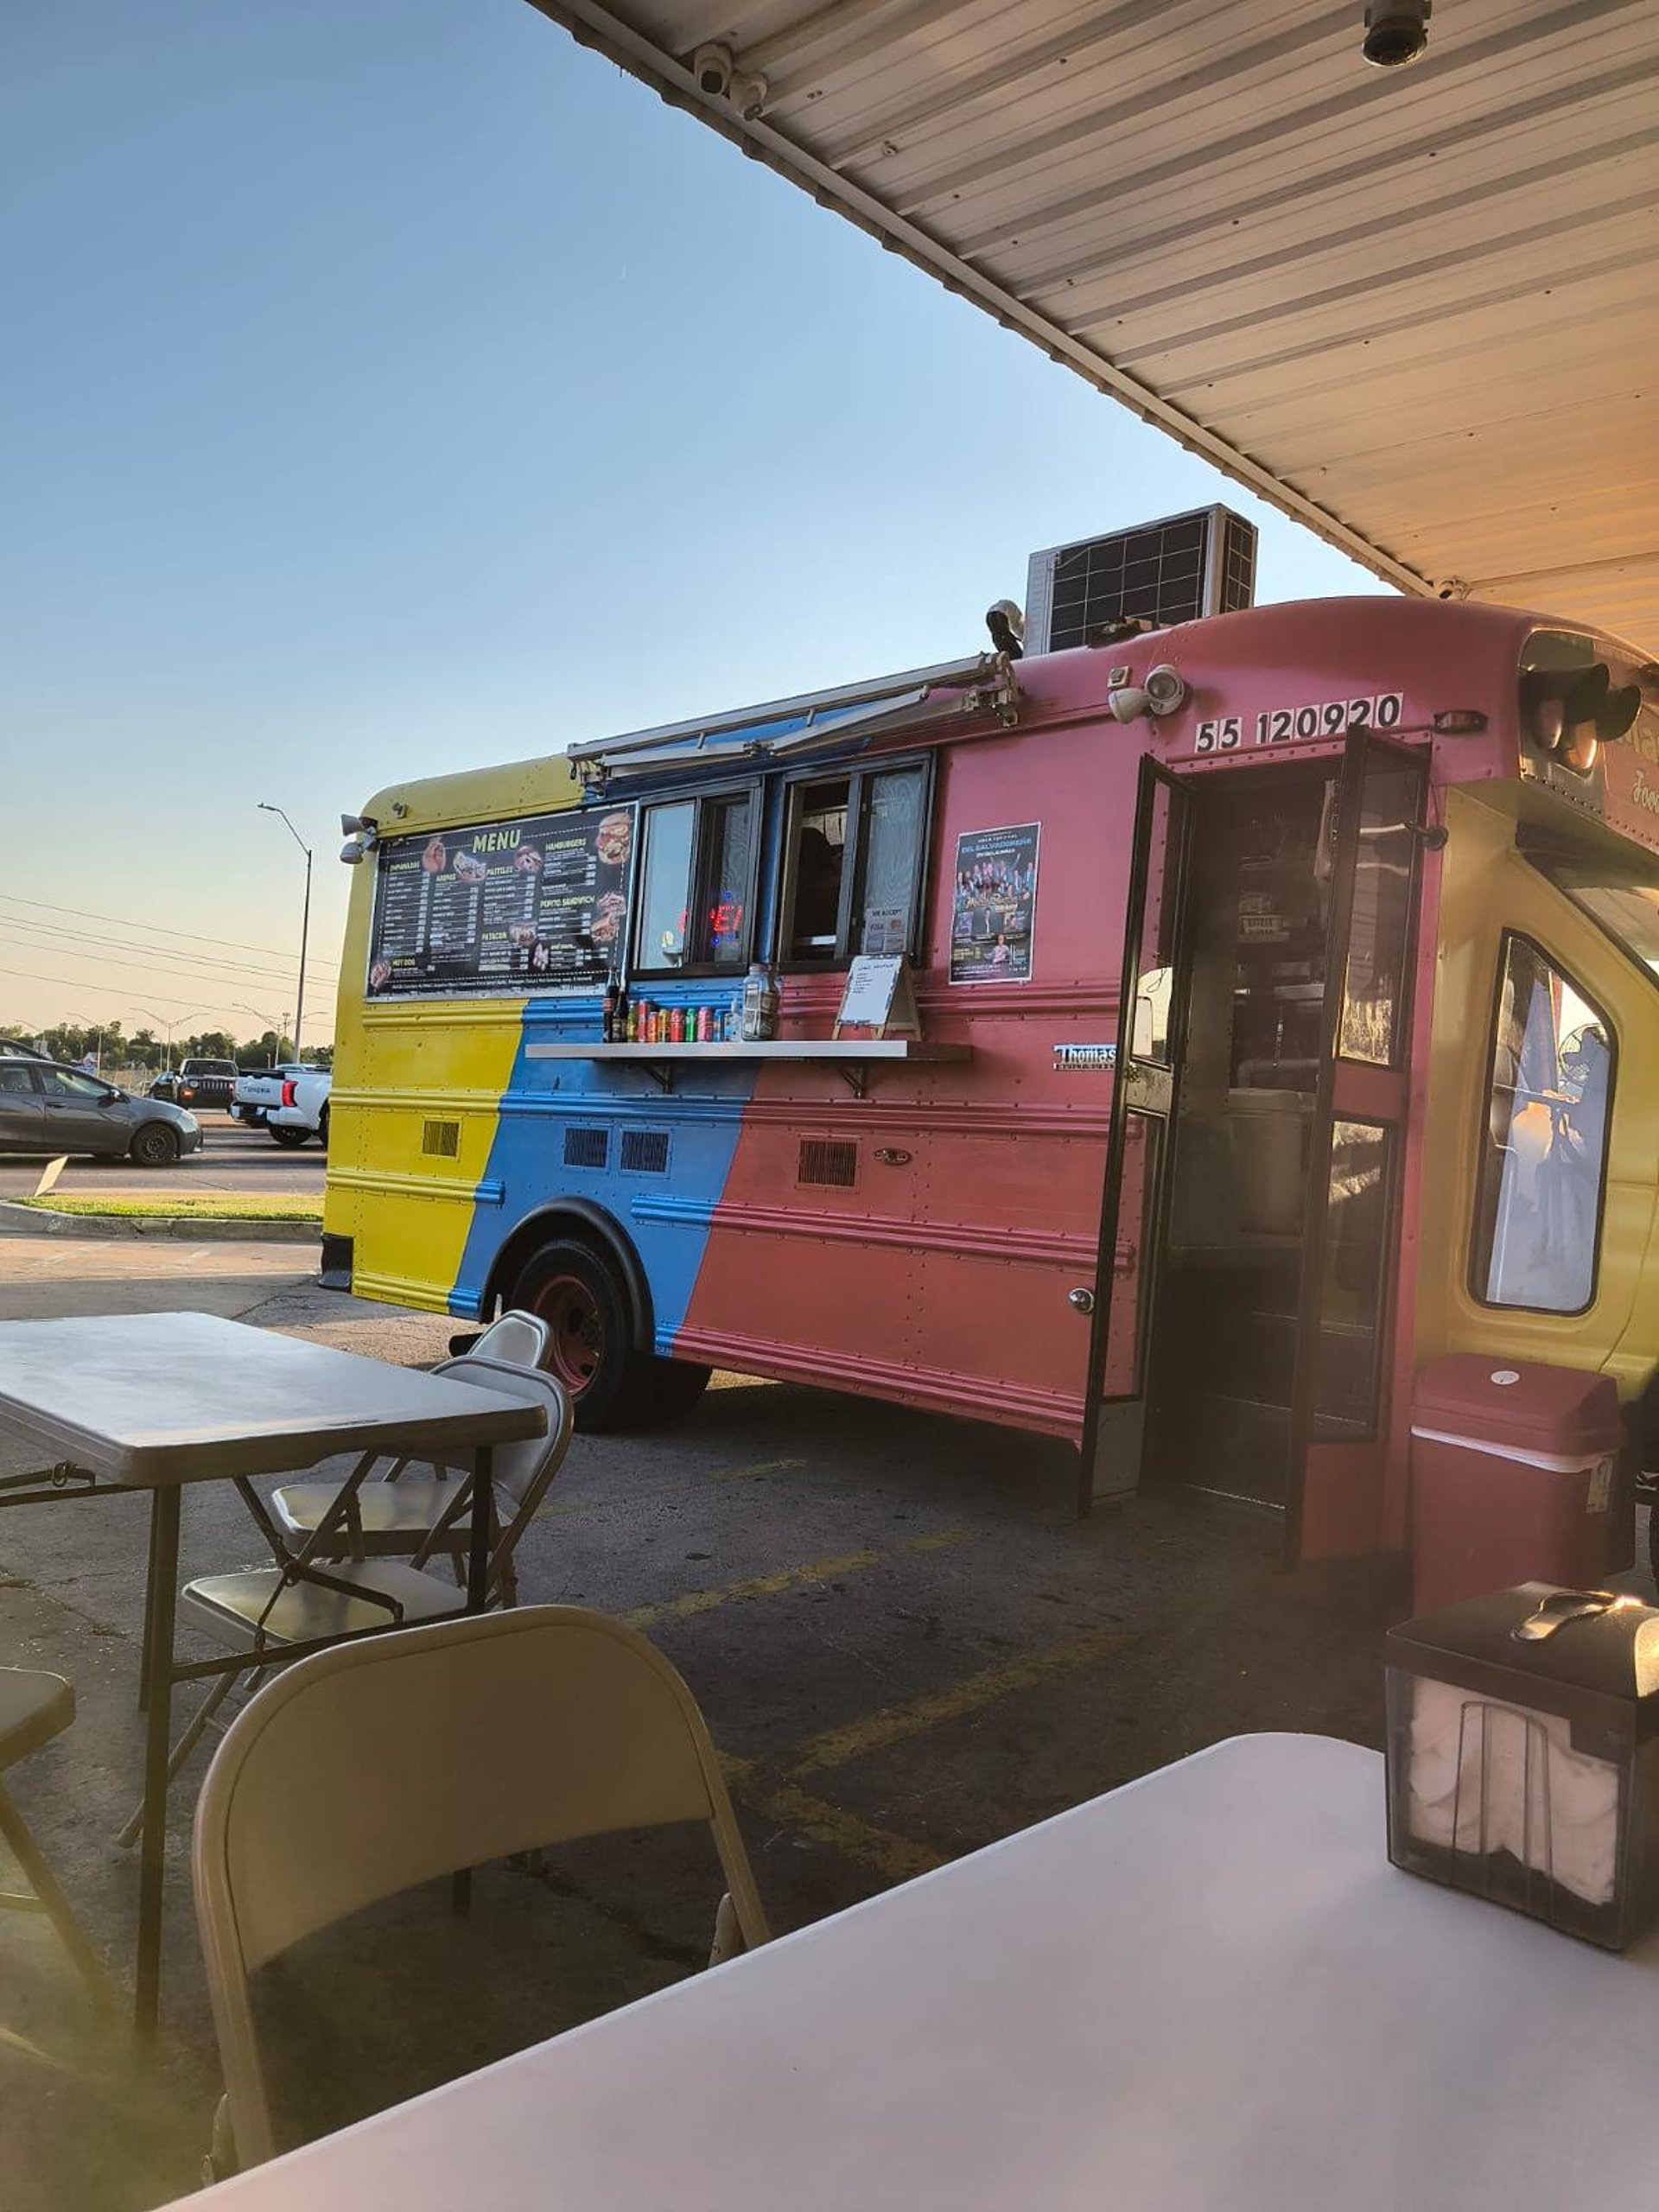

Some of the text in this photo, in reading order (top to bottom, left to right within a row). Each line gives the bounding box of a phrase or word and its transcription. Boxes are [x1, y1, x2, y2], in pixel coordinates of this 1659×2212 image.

[1198, 695, 1401, 753] 55 120920
[472, 829, 520, 854] MENU
[1053, 1044, 1117, 1064] Thomas
